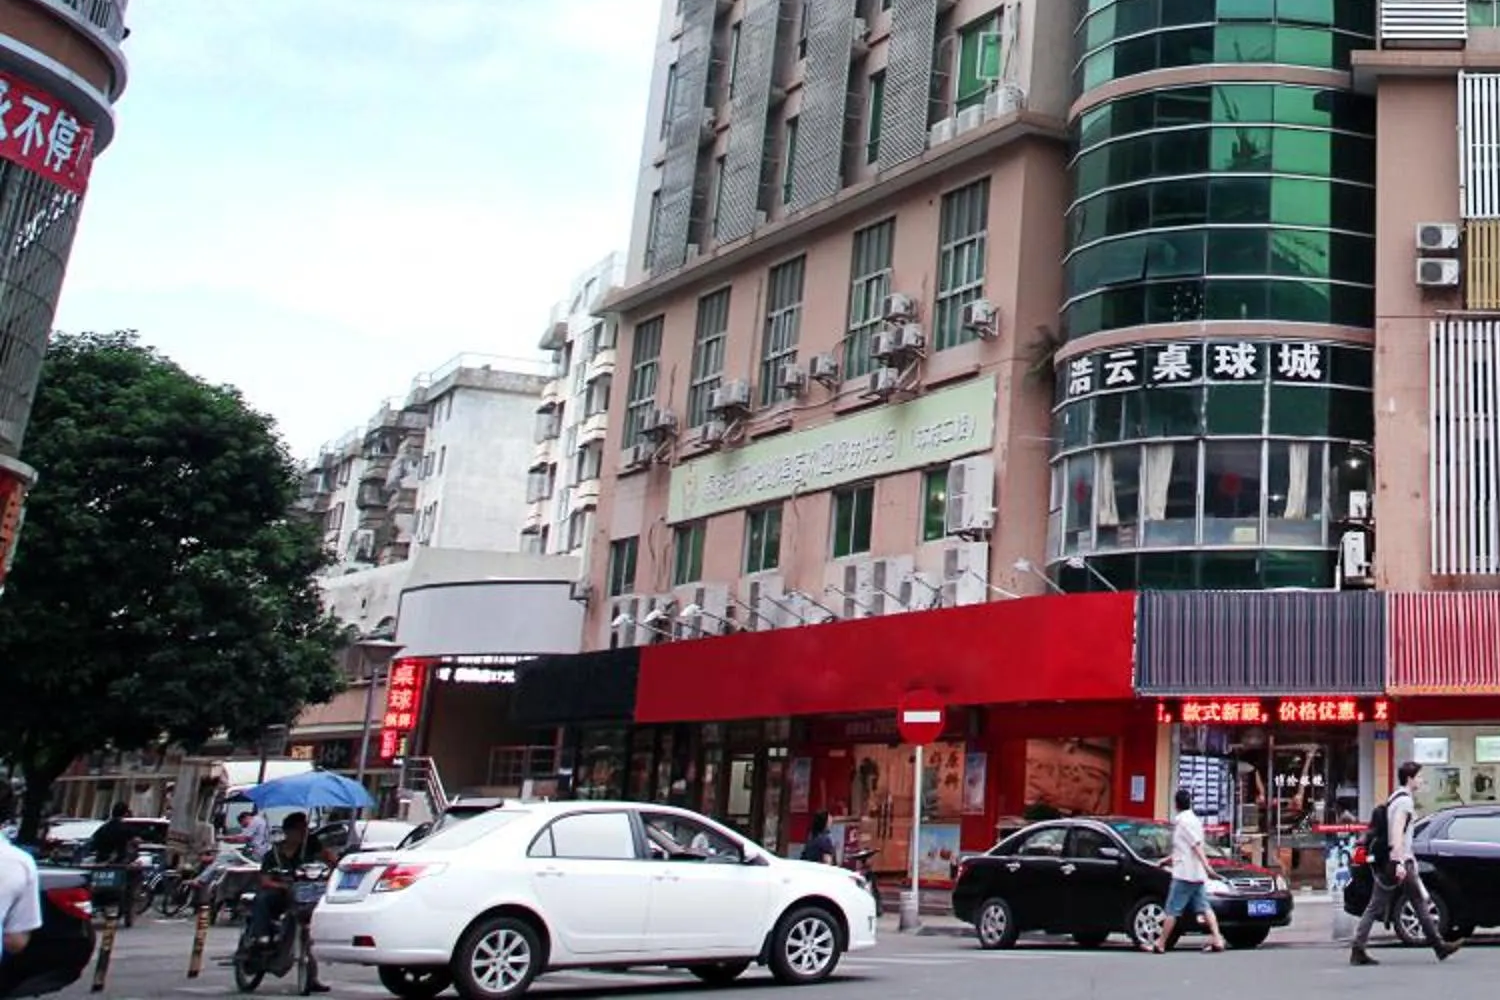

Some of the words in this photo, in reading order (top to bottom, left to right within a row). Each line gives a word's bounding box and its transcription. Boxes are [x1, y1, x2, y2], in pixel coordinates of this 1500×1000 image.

[1069, 342, 1321, 395] 浩云桌球城
